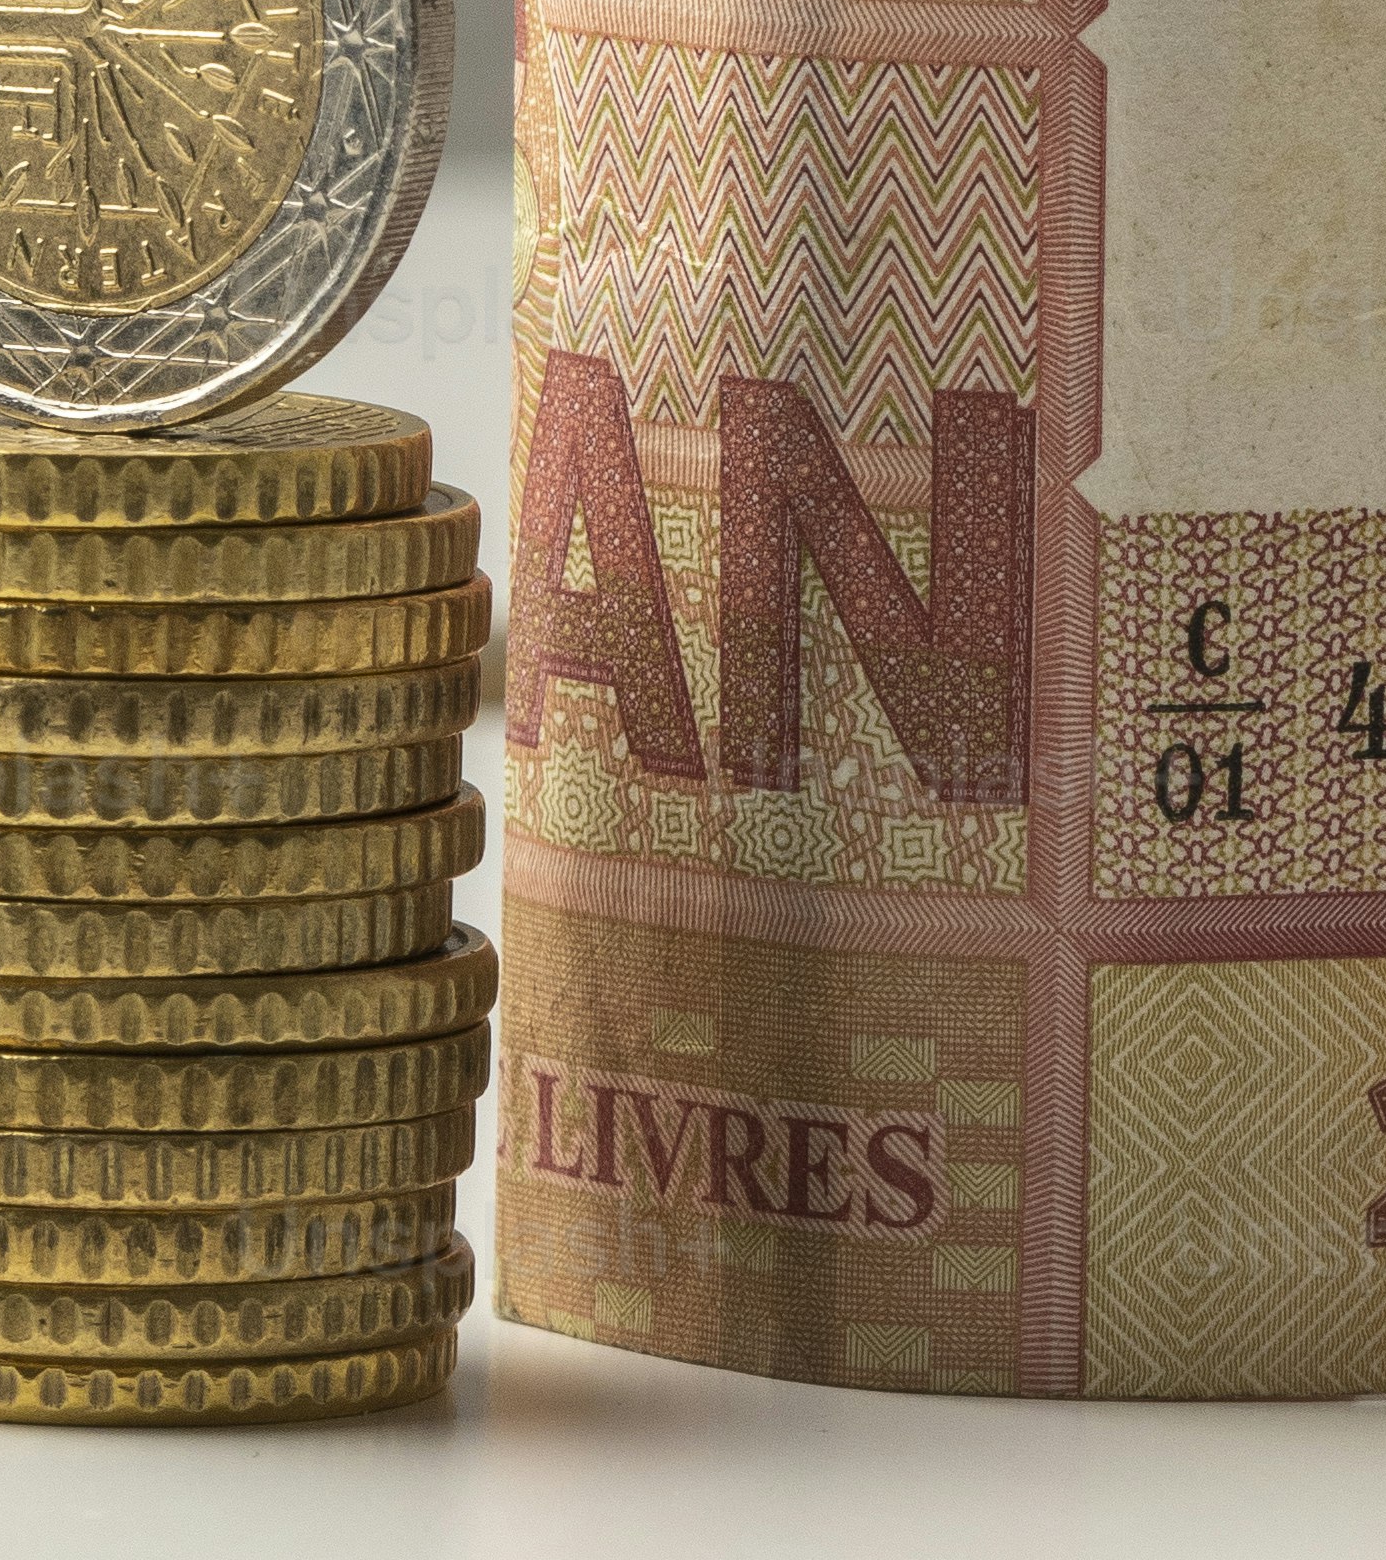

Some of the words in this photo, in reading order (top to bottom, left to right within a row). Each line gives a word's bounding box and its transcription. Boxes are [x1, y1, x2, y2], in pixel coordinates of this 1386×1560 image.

[505, 350, 1037, 804] AN
[1188, 599, 1232, 678] C
[1154, 742, 1255, 824] 01
[531, 1069, 936, 1229] LIVRES
